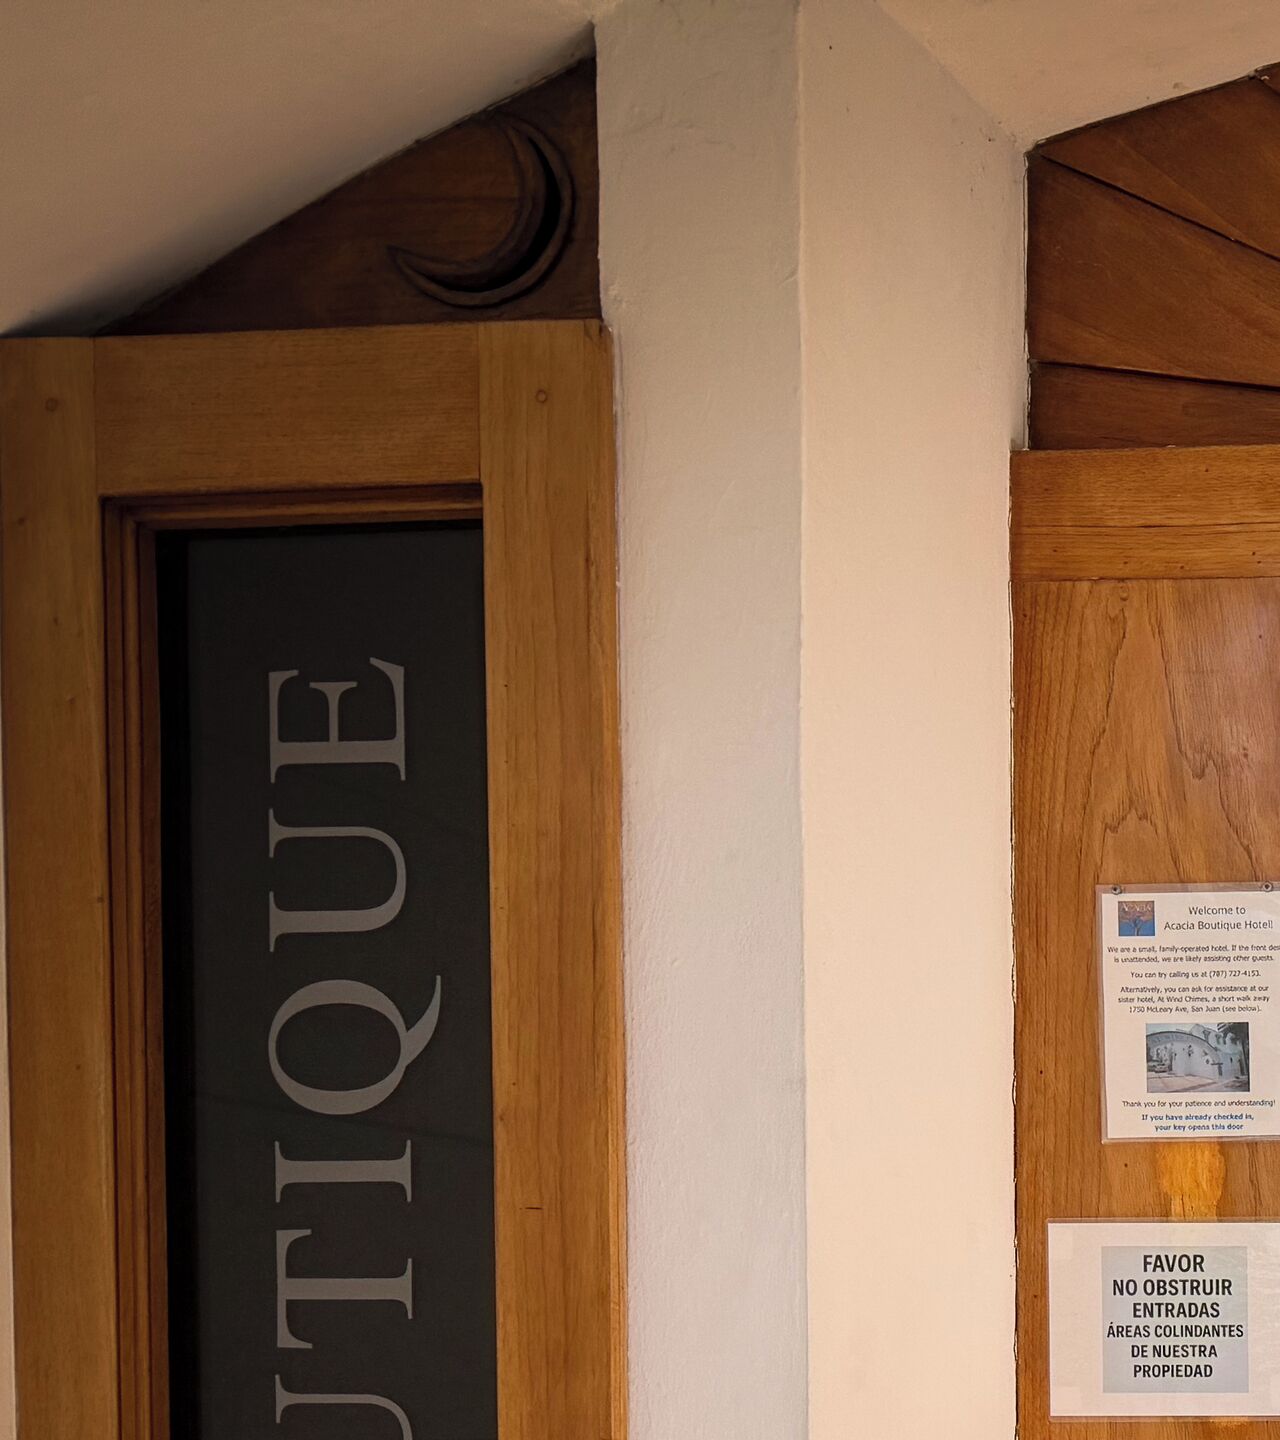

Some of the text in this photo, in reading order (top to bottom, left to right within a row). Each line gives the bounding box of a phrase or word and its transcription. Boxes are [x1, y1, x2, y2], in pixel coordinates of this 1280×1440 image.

[1188, 906, 1233, 915] Welcome
[1164, 919, 1273, 931] Acacia Boutique Hotel!
[1138, 945, 1157, 953] small,
[1159, 945, 1209, 954] family-operated
[1211, 944, 1229, 952] hotel.
[1121, 955, 1159, 963] unattended,
[1185, 955, 1201, 963] likely
[1158, 971, 1167, 979] try
[1169, 970, 1189, 979] calling
[1120, 986, 1162, 994] Alternatively,
[1191, 985, 1202, 994] ask
[1146, 1006, 1173, 1014] McLeary
[1222, 1005, 1236, 1013] (see
[1227, 1099, 1275, 1107] understanding!
[1184, 1113, 1212, 1121] already
[1173, 1124, 1186, 1132] key
[1143, 1254, 1204, 1272] FAVOR
[1113, 1278, 1232, 1296] NO OBSTRUIR
[1133, 1302, 1220, 1318] ENTRADAS
[1106, 1321, 1243, 1338] ÁREAS COLINDANTES
[1131, 1344, 1217, 1358] DE NUESTRA
[1133, 1364, 1212, 1377] PROPIEDAD
